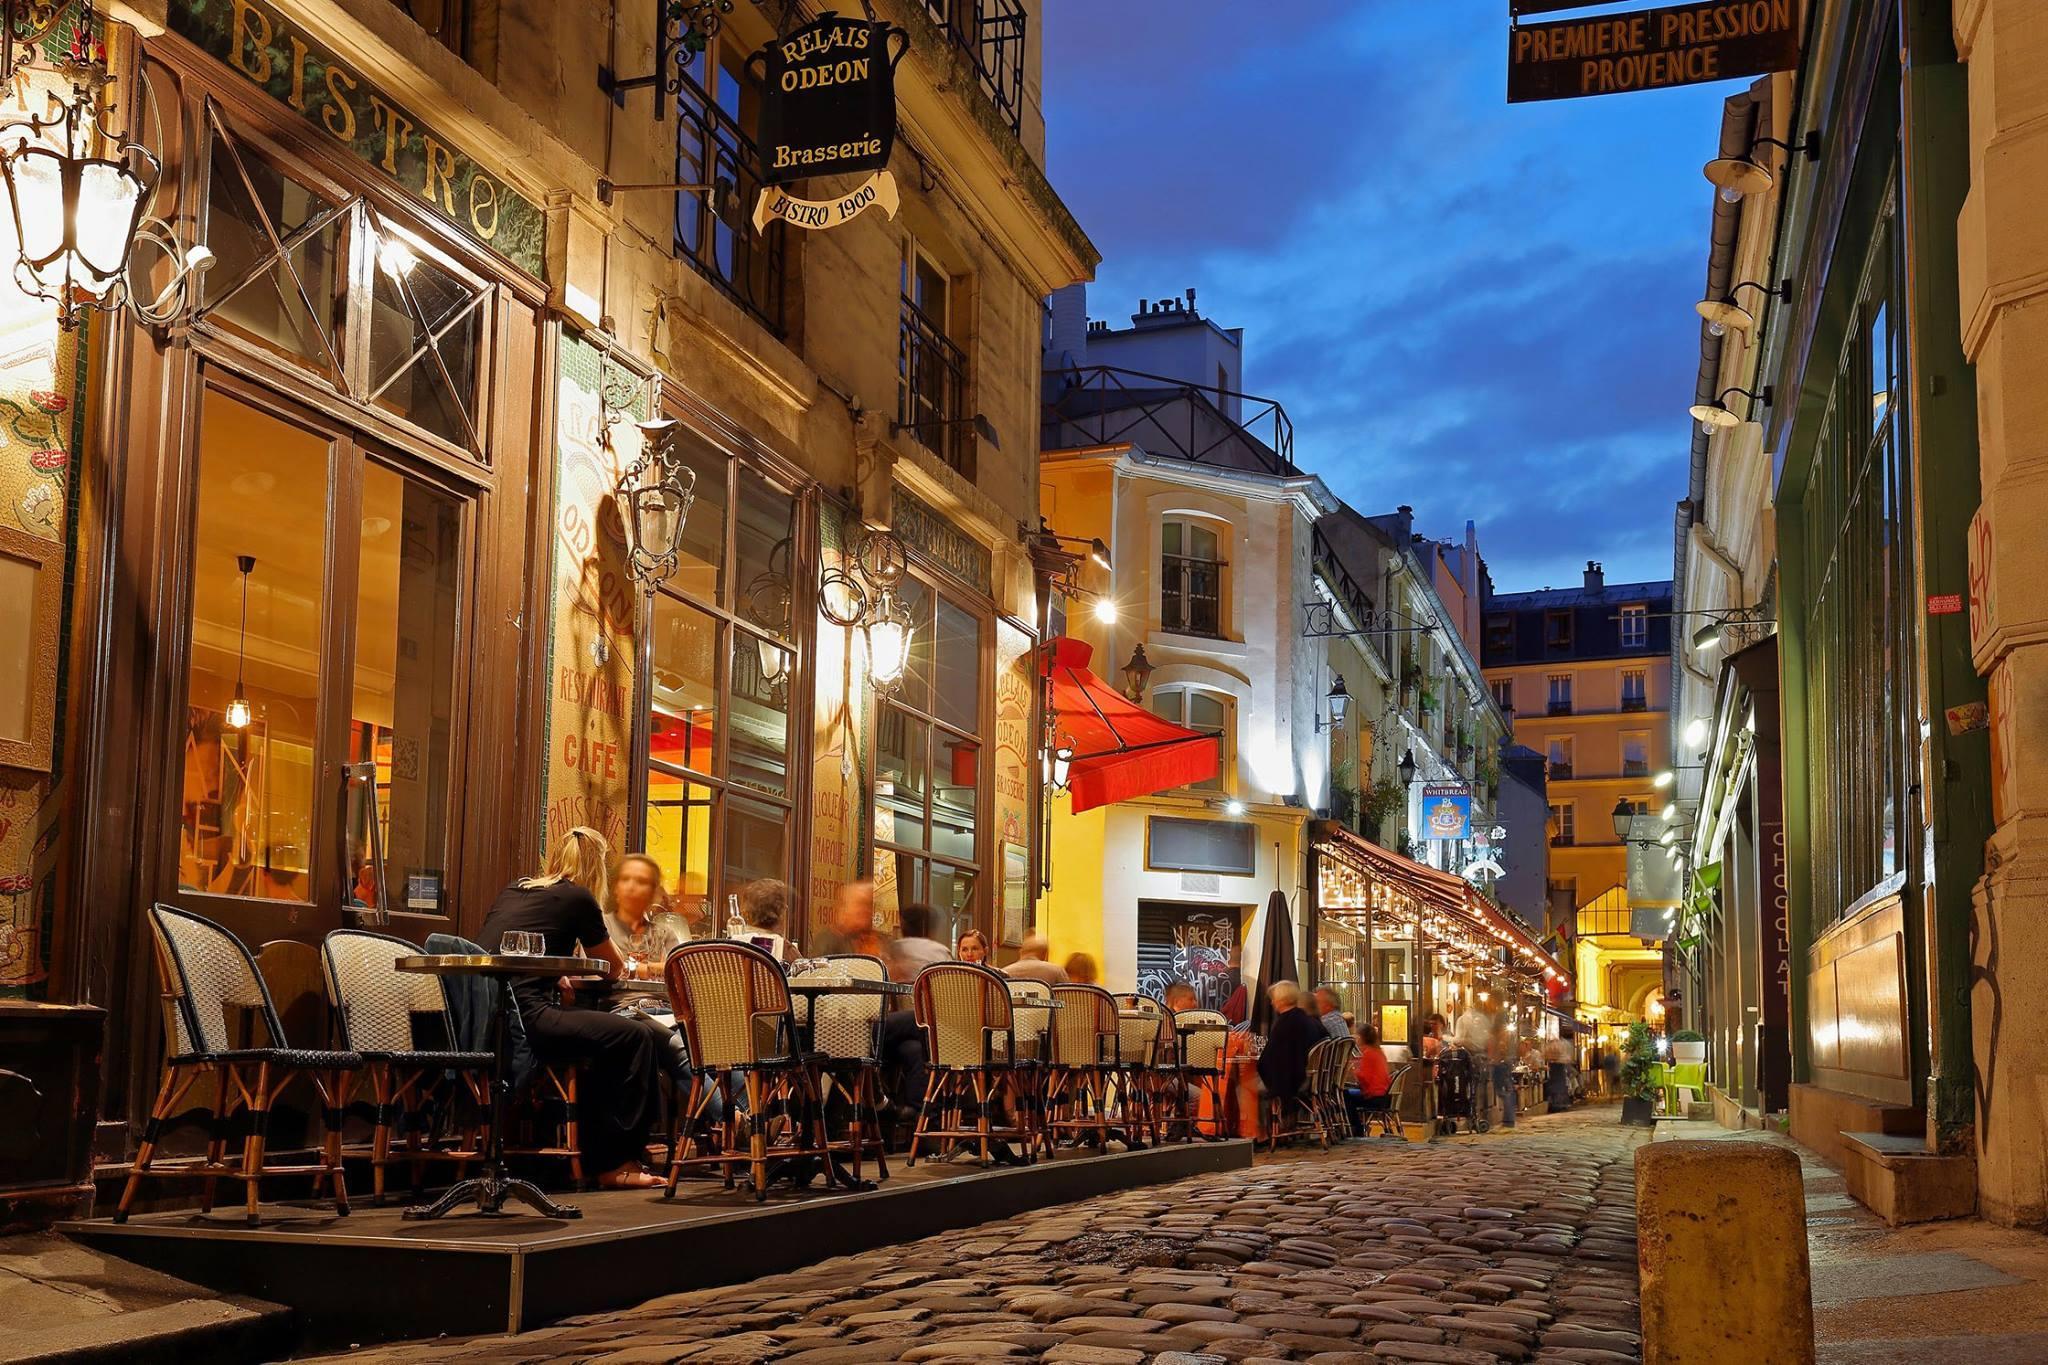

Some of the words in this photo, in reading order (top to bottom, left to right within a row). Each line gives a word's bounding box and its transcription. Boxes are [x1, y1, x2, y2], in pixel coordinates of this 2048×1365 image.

[781, 26, 871, 65] RELAIS
[1515, 18, 1646, 64] PREMIERE
[1661, 0, 1791, 47] PRESSION
[781, 58, 871, 92] ODEON
[1581, 45, 1720, 94] PROVENCE
[228, 0, 498, 240] BISTRO
[773, 132, 882, 168] Brasserie
[768, 195, 829, 227] BISTRO
[836, 185, 877, 221] 1900
[563, 503, 633, 623] ODON
[560, 665, 627, 720] RESTAURANT
[999, 673, 1028, 708] RELAIS
[563, 734, 619, 780] CAFÉ
[997, 722, 1027, 759] ODEON
[996, 774, 1025, 802] BRASSERIE
[1425, 788, 1468, 796] WHITBREAD
